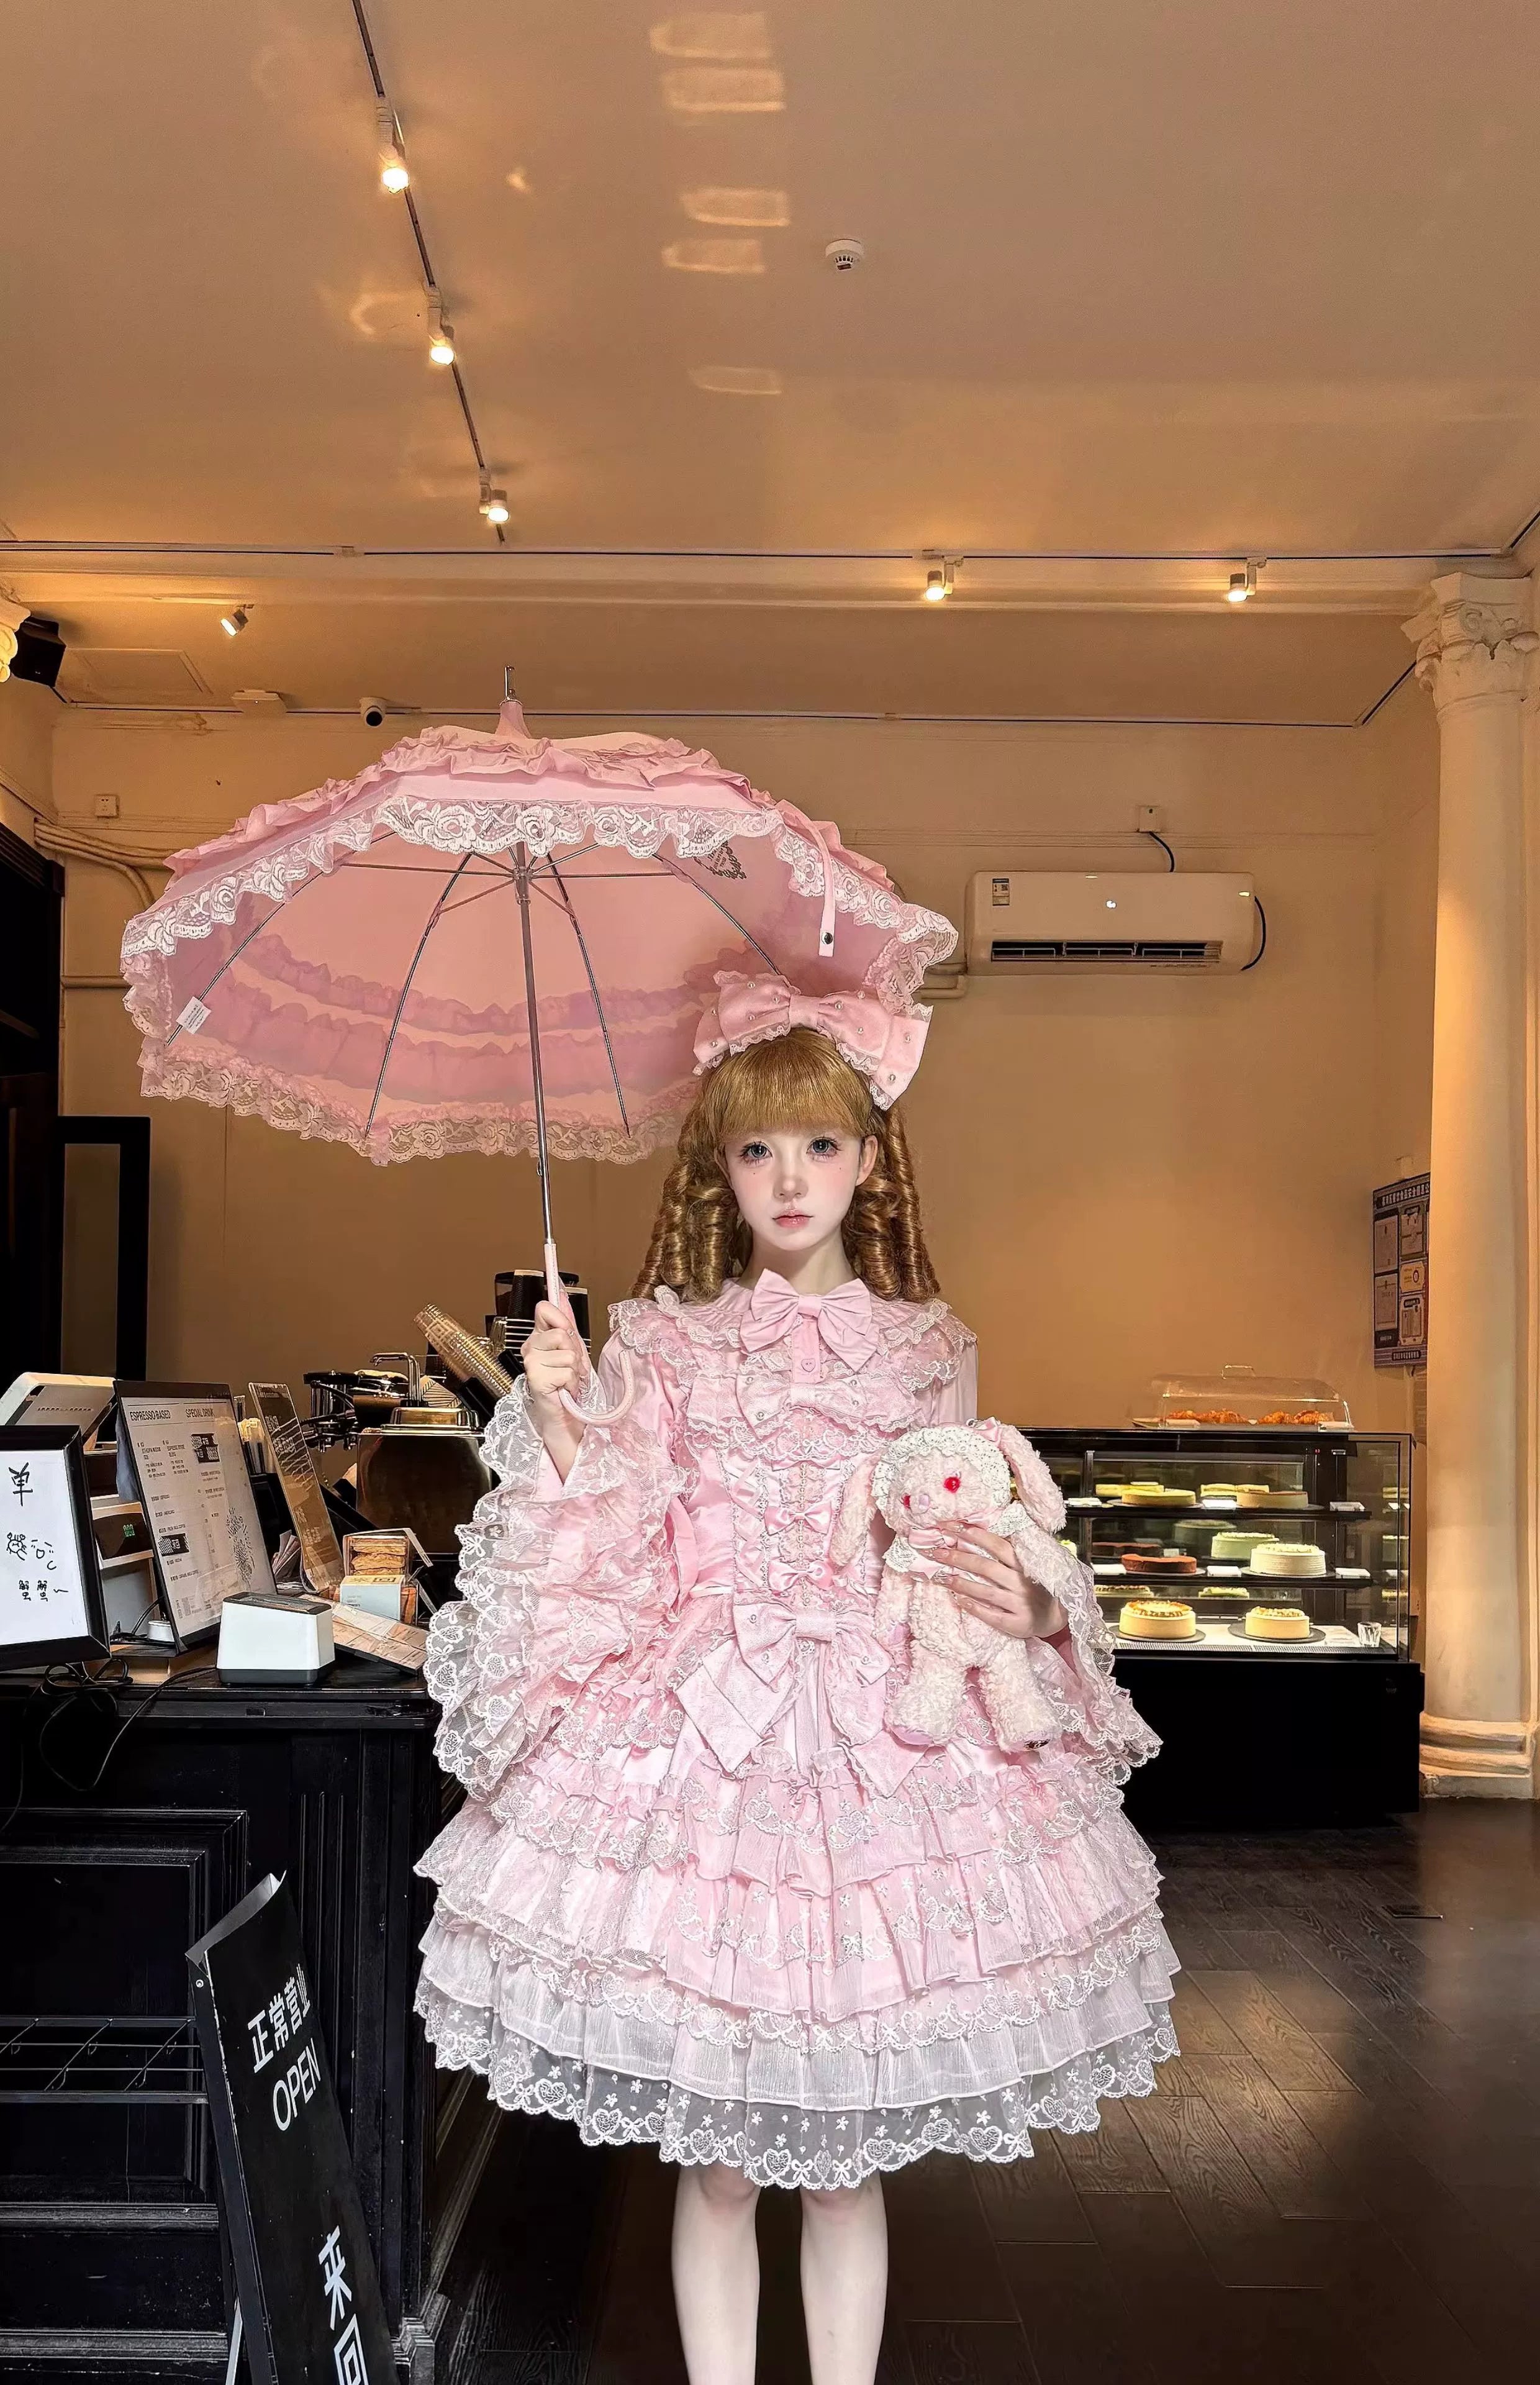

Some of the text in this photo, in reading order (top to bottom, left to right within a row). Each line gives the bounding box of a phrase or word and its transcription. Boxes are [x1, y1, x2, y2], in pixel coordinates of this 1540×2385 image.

[129, 1409, 171, 1421] ESPRESSO BASED
[186, 1408, 202, 1418] SPECIAL
[8, 1462, 34, 1507] 单
[248, 1963, 310, 2073] 正常营业
[273, 2037, 321, 2132] OPEN
